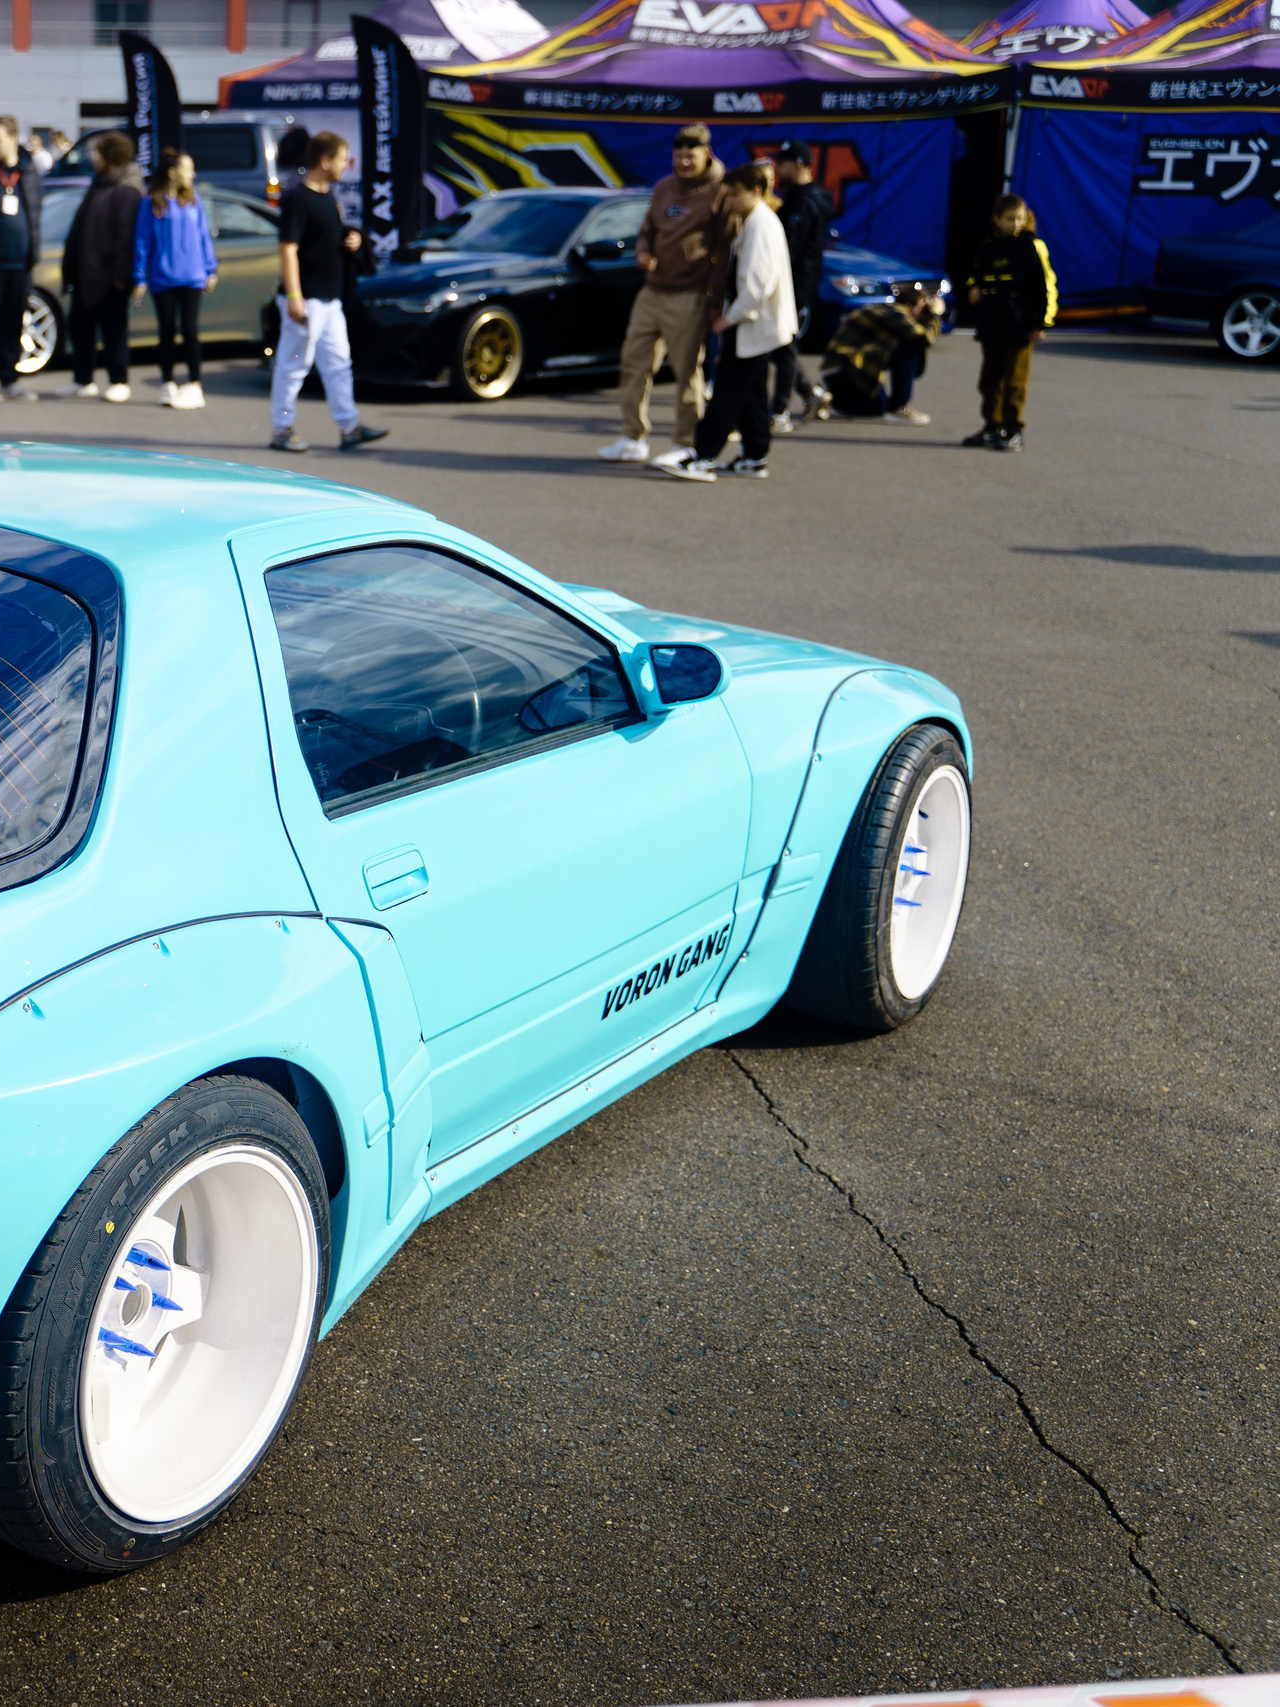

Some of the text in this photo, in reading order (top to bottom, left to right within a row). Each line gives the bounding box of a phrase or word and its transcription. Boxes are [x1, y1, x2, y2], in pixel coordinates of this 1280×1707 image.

[132, 52, 152, 129] Россия
[263, 82, 324, 101] NIKITA
[1149, 78, 1280, 100] 新世紀エヴァン
[1139, 137, 1280, 200] エヴ
[601, 923, 730, 1021] VORON GANG
[63, 1121, 190, 1311] MAXTREK
